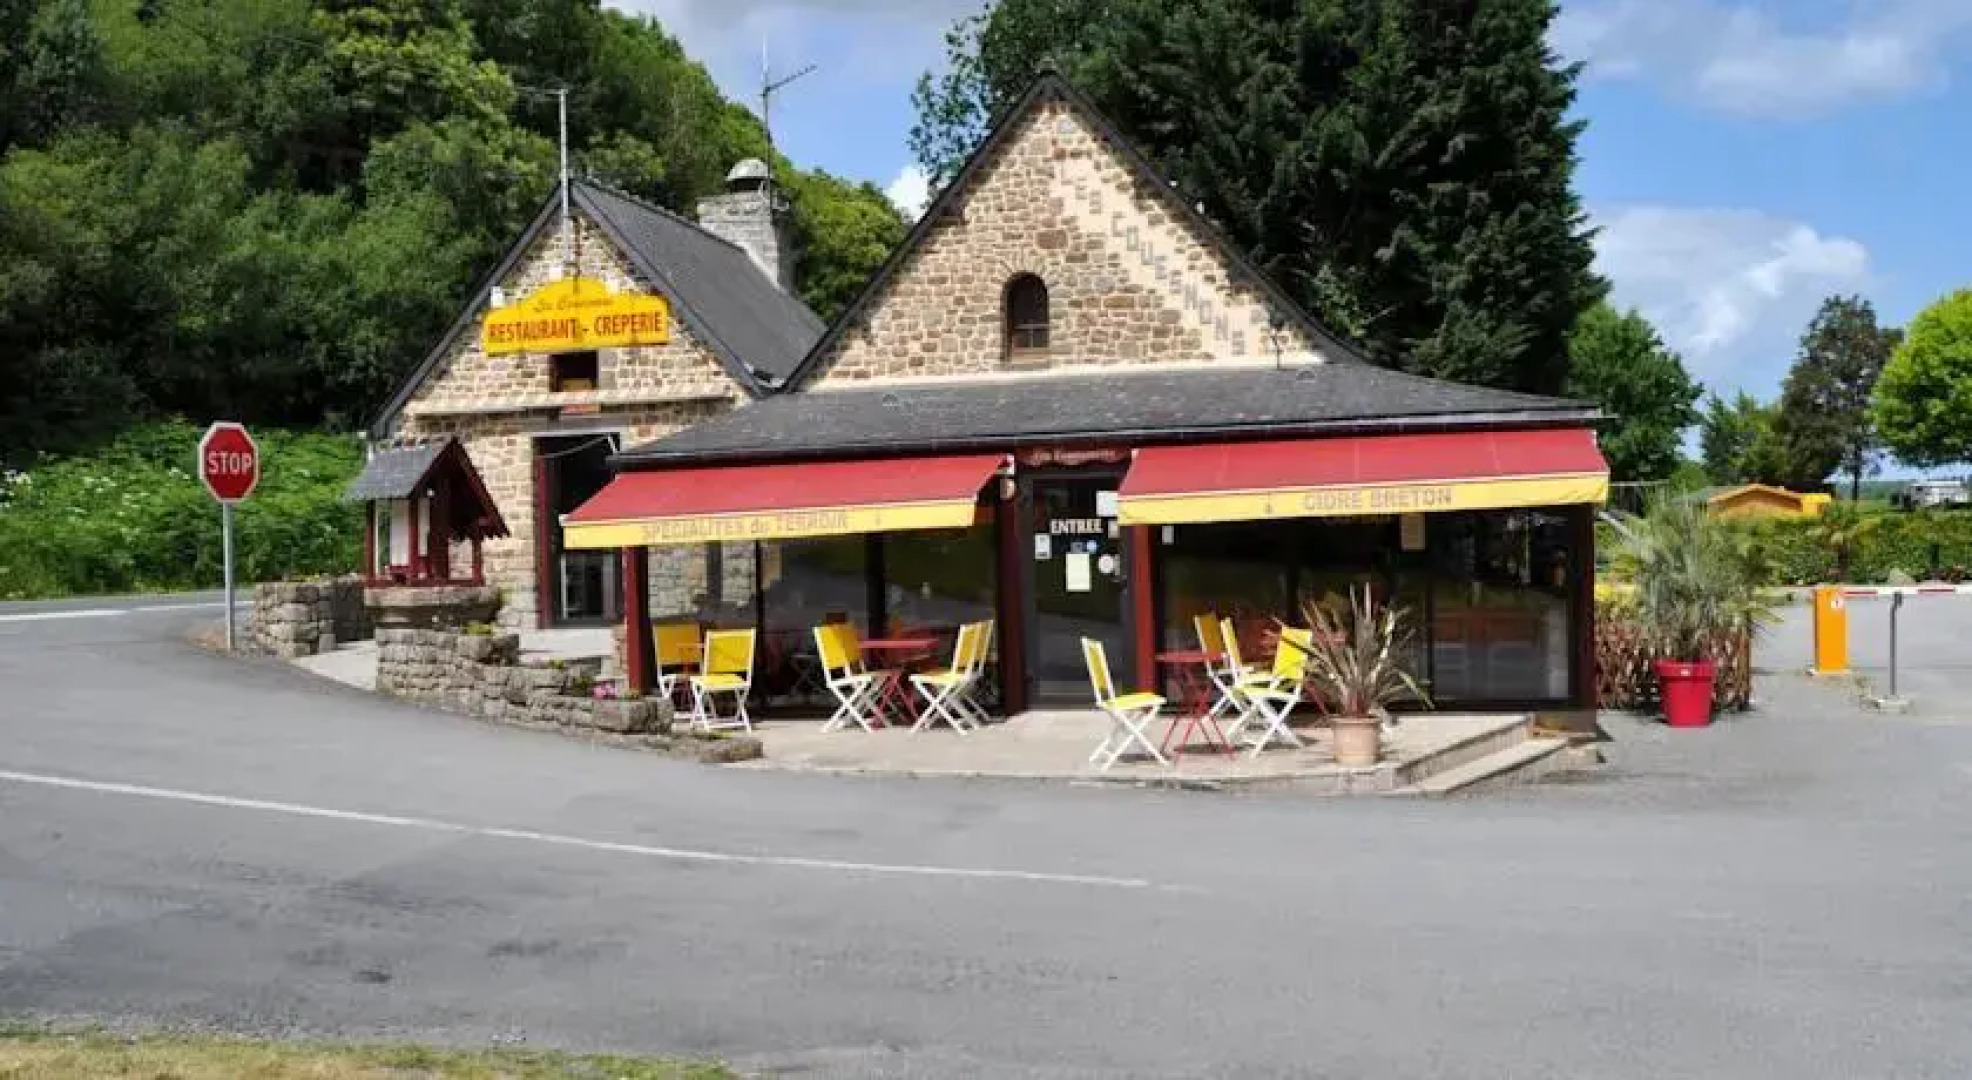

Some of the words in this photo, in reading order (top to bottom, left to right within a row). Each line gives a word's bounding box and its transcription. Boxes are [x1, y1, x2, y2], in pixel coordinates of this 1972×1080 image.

[1111, 211, 1246, 355] COUESNONS
[488, 319, 576, 344] RESTAURANT
[594, 312, 663, 335] CREPERIE
[208, 451, 252, 475] STOP
[1303, 490, 1362, 511] CIDRE
[1370, 487, 1452, 509] BRETON
[642, 516, 745, 541] SPECIALITES
[776, 510, 848, 531] TERROIR
[1051, 518, 1103, 534] ENTREE
